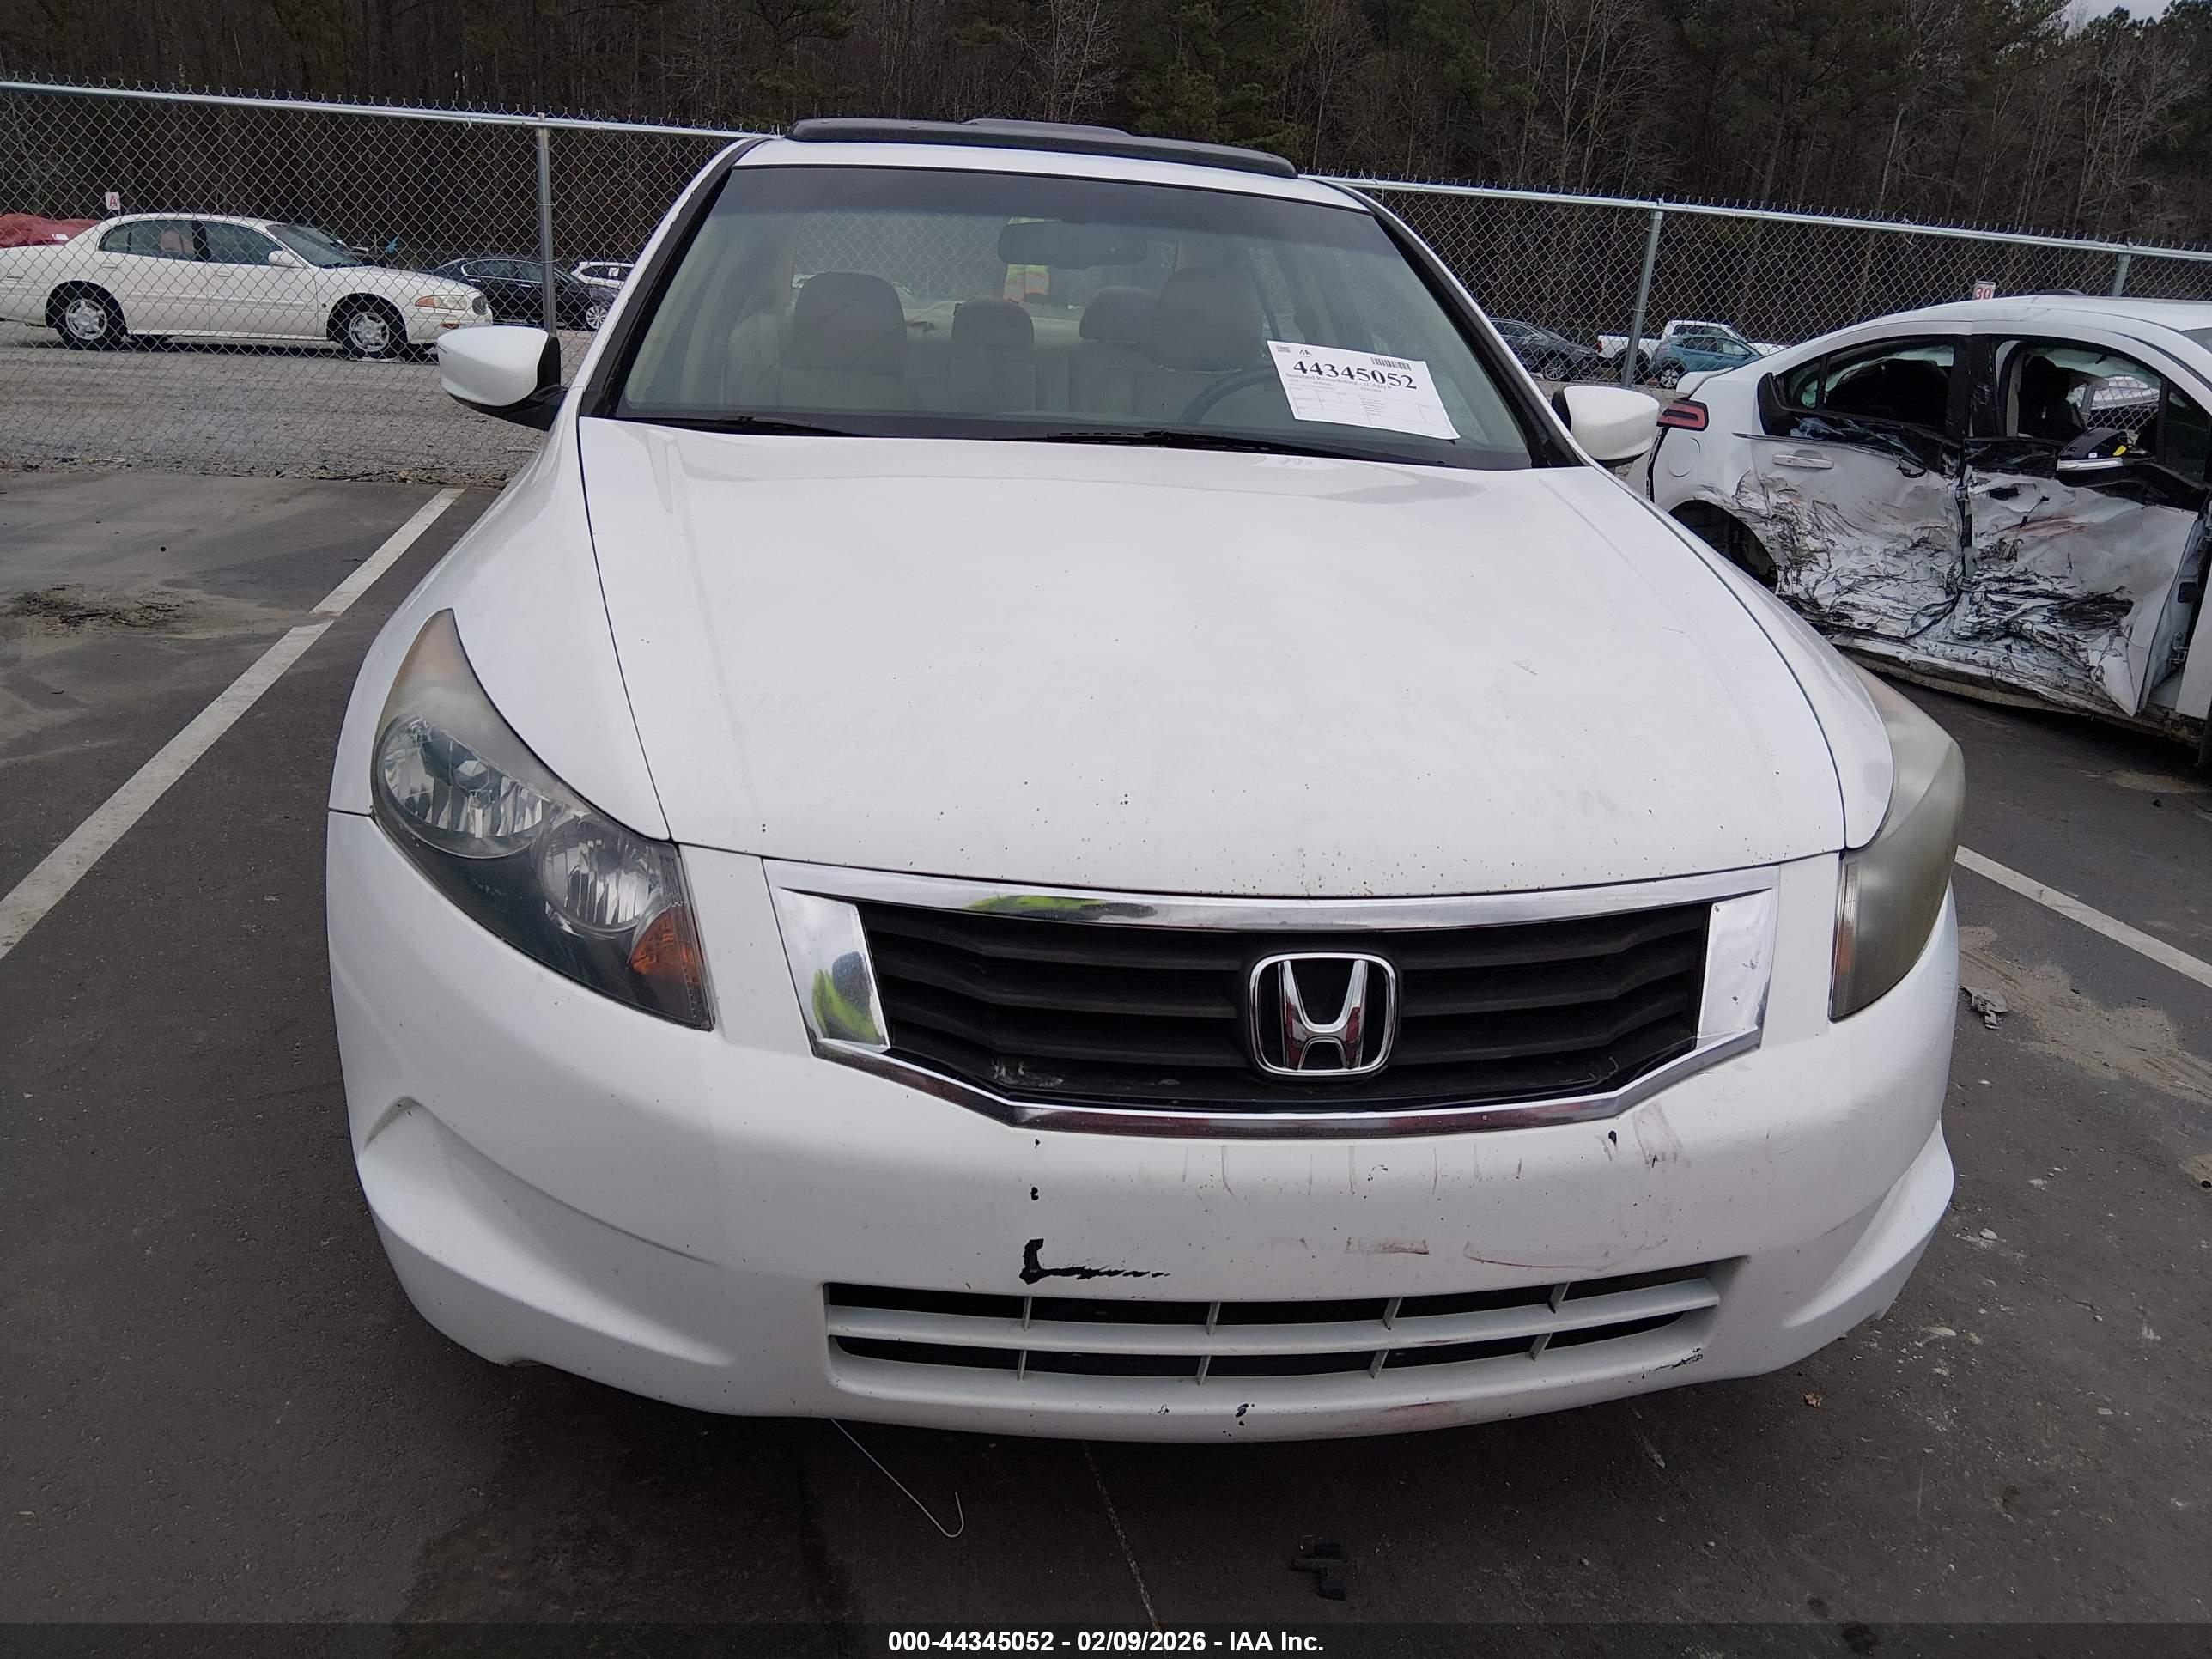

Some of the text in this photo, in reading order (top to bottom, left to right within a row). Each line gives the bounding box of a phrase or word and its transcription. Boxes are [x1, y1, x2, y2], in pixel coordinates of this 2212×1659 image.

[109, 195, 118, 207] A
[1975, 287, 1992, 300] 30
[1293, 361, 1417, 389] 44345052
